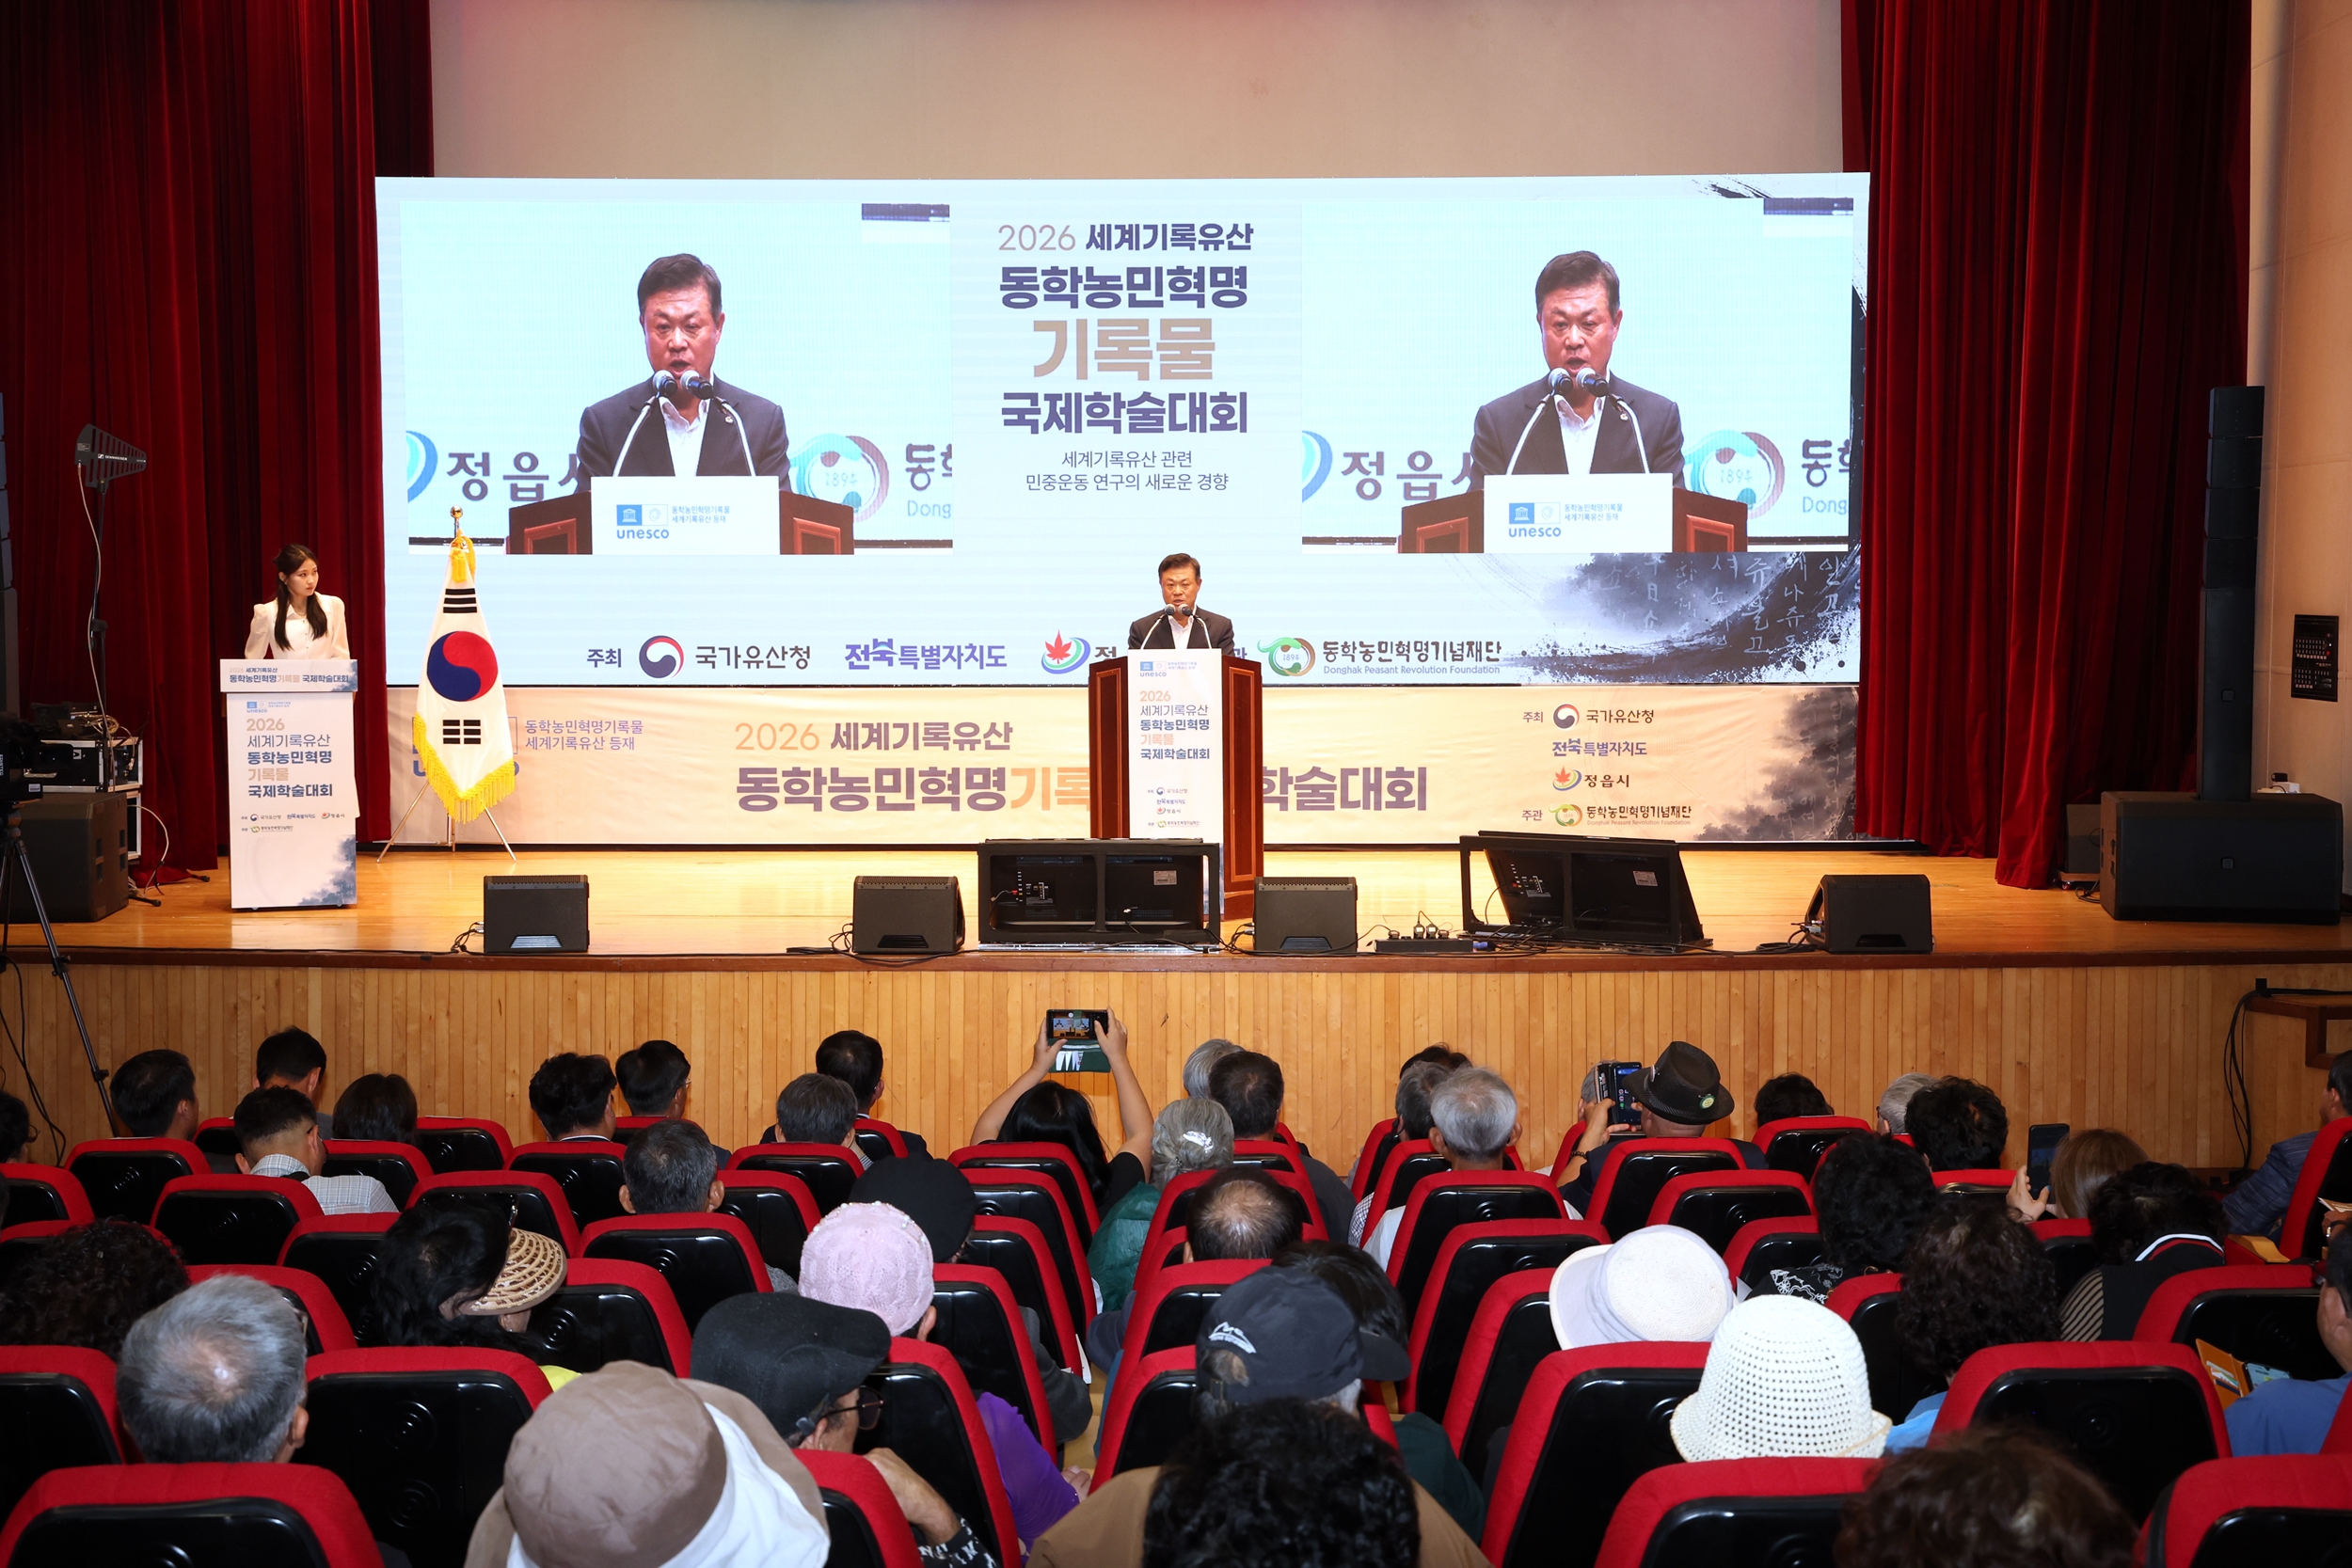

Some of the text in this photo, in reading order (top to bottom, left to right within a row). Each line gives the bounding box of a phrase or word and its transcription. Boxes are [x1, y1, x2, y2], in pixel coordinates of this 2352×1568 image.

[998, 223, 1254, 251] 2026 세계기록유산
[999, 265, 1248, 309] 동학농민혁명
[1033, 318, 1216, 381] 기록물
[1001, 391, 1248, 435] 국제학술대회
[1061, 451, 1193, 468] 세계기록유산 관련
[1026, 473, 1230, 491] 민중운동 연구의 새로운 경향
[616, 529, 669, 539] unesco
[1509, 527, 1561, 537] unesco
[587, 648, 622, 668] 주최
[695, 645, 810, 670] 국가유산청
[845, 639, 1008, 670] 전북특별자치도
[1323, 641, 1502, 662] 동학농민혁명기념재단
[1324, 665, 1500, 675] Donghak Peasant Revolution Foundation
[302, 674, 348, 683] 국제학술대회
[1139, 690, 1171, 703] 2026
[1140, 705, 1208, 716] 세계기록유산
[1522, 709, 1654, 723] 주최 국가유산청
[246, 719, 285, 732] 2026
[525, 720, 644, 734] 동학농민혁명기록물
[1140, 720, 1210, 731] 동학농민혁명
[247, 735, 330, 748] 세계기록유산
[735, 721, 1013, 751] 2026 세계기록유산
[1140, 734, 1173, 745] 기록물
[525, 736, 635, 751] 세계기록유산 등재
[1552, 738, 1647, 756] 전북특별자치도
[247, 751, 332, 765] 동학농민혁명
[1140, 749, 1210, 760] 국제학술대회
[248, 768, 289, 782] 기록물
[1584, 774, 1629, 788] 정읍시
[248, 784, 332, 798] 국제학술대회
[1521, 810, 1543, 821] 주관
[1586, 806, 1692, 818] 동학농민혁명기념재단
